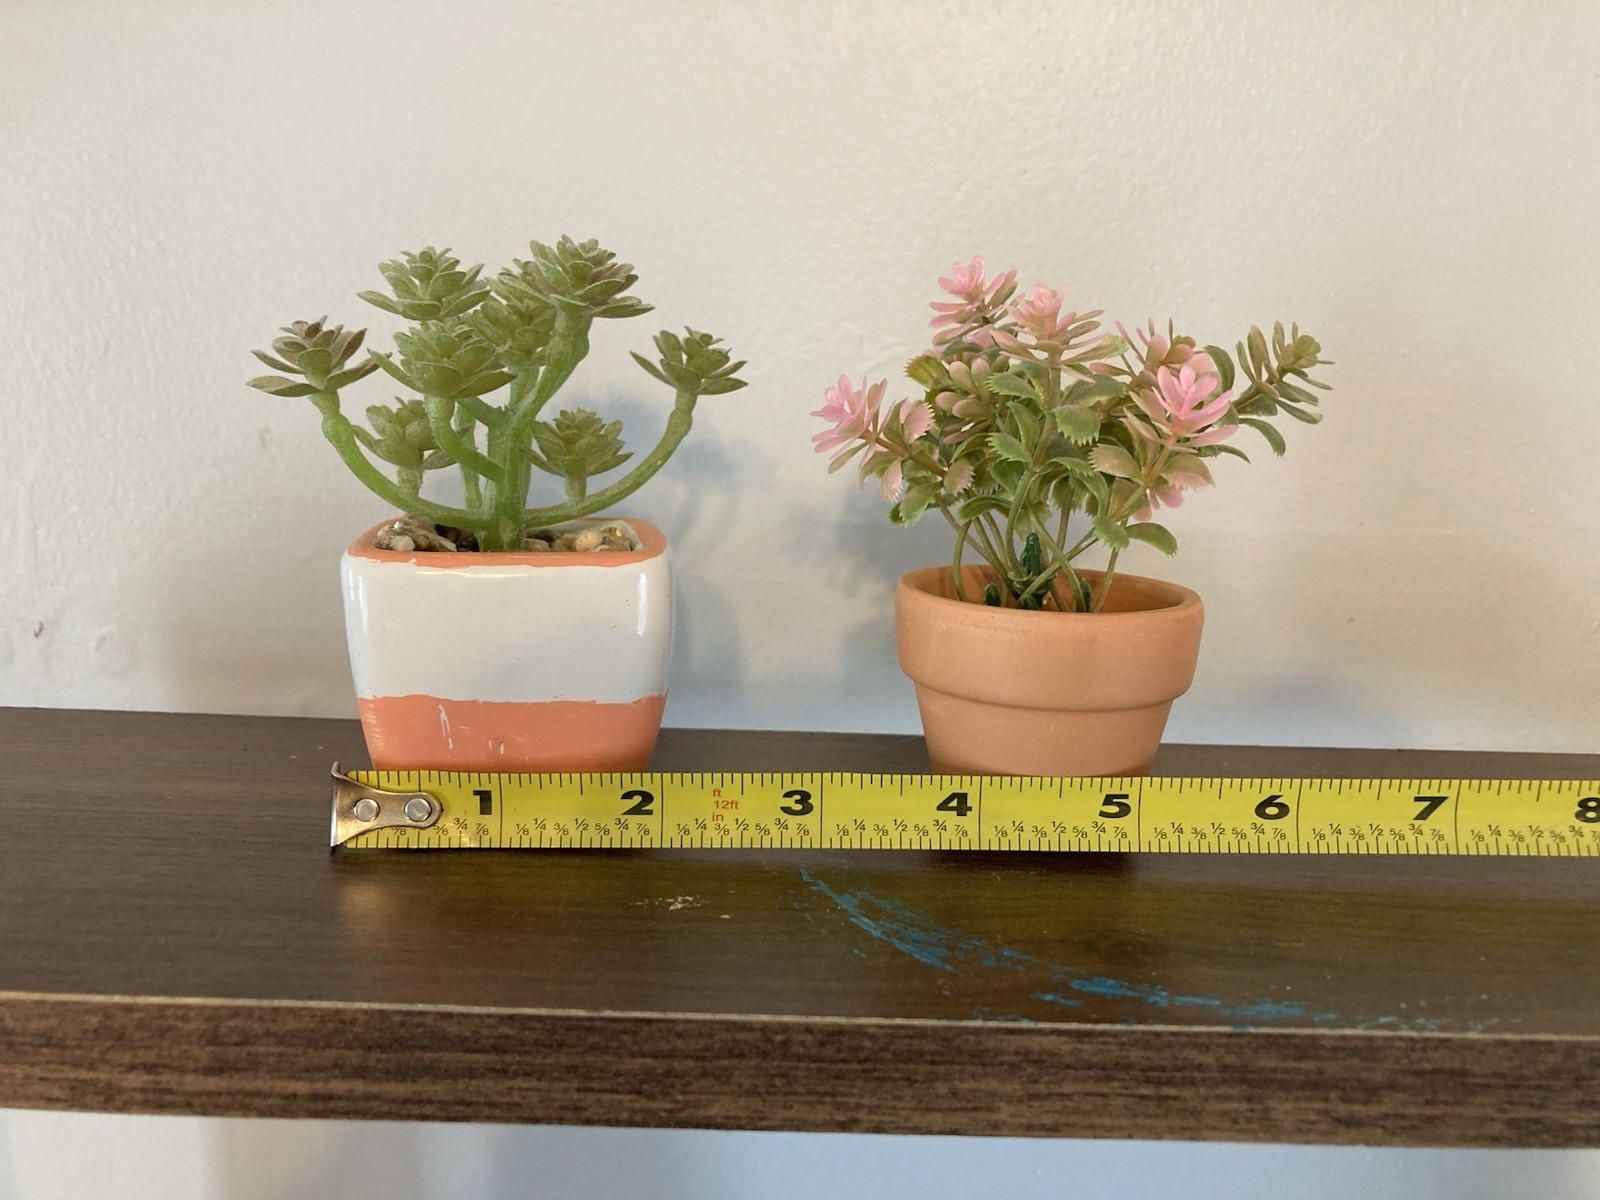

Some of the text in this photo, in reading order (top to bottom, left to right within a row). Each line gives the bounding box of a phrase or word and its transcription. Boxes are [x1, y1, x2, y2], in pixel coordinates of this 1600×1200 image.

[713, 789, 721, 797] ft
[473, 790, 1600, 823] 1 2 3 4 5 6 7 8
[714, 800, 739, 809] 12ft
[712, 813, 724, 821] in
[453, 818, 467, 830] 3/4
[475, 823, 489, 835] 7/8
[516, 823, 529, 835] 1/8
[534, 818, 546, 830] 1/4
[554, 824, 569, 835] 3/8
[574, 818, 589, 830] 1/2
[595, 823, 610, 835] 5/8
[615, 818, 629, 830] 3/4
[637, 823, 650, 835] 7/8
[676, 824, 690, 835] 1/8
[694, 818, 707, 830] 1/4
[715, 824, 730, 835] 3/8
[735, 818, 749, 830] 1/2
[755, 824, 770, 835] 5/8
[775, 818, 788, 830] 3/4
[796, 823, 810, 835] 7/8
[836, 824, 849, 836] 1/8
[853, 819, 866, 831] 1/4
[873, 824, 888, 836] 3/8
[893, 819, 907, 831] 1/2
[914, 824, 929, 836] 5/8
[933, 819, 947, 831] 3/4
[955, 825, 968, 837] 7/8
[994, 826, 1008, 837] 1/8
[1012, 820, 1024, 832] 1/4
[1032, 826, 1047, 838] 3/8
[1052, 821, 1066, 833] 1/2
[1072, 826, 1088, 838] 5/8
[1092, 821, 1106, 833] 3/4
[1114, 827, 1127, 839] 7/8
[1154, 827, 1167, 839] 1/8
[1171, 822, 1184, 834] 1/4
[1191, 827, 1207, 839] 3/8
[1211, 822, 1226, 834] 1/2
[1232, 828, 1247, 840] 5/8
[1251, 823, 1265, 835] 3/4
[1272, 828, 1286, 840] 7/8
[1312, 828, 1326, 840] 1/8
[1329, 823, 1342, 835] 1/4
[1350, 828, 1365, 840] 3/8
[1369, 823, 1384, 835] 1/2
[1390, 829, 1405, 841] 5/8
[1409, 823, 1423, 835] 3/4
[1430, 829, 1445, 841] 7/8
[1471, 830, 1485, 841] 1/8
[1488, 824, 1501, 837] 1/4
[1509, 830, 1525, 842] 3/8
[1528, 825, 1544, 837] 1/2
[1550, 831, 1566, 842] 5/8
[1569, 825, 1584, 838] 3/4
